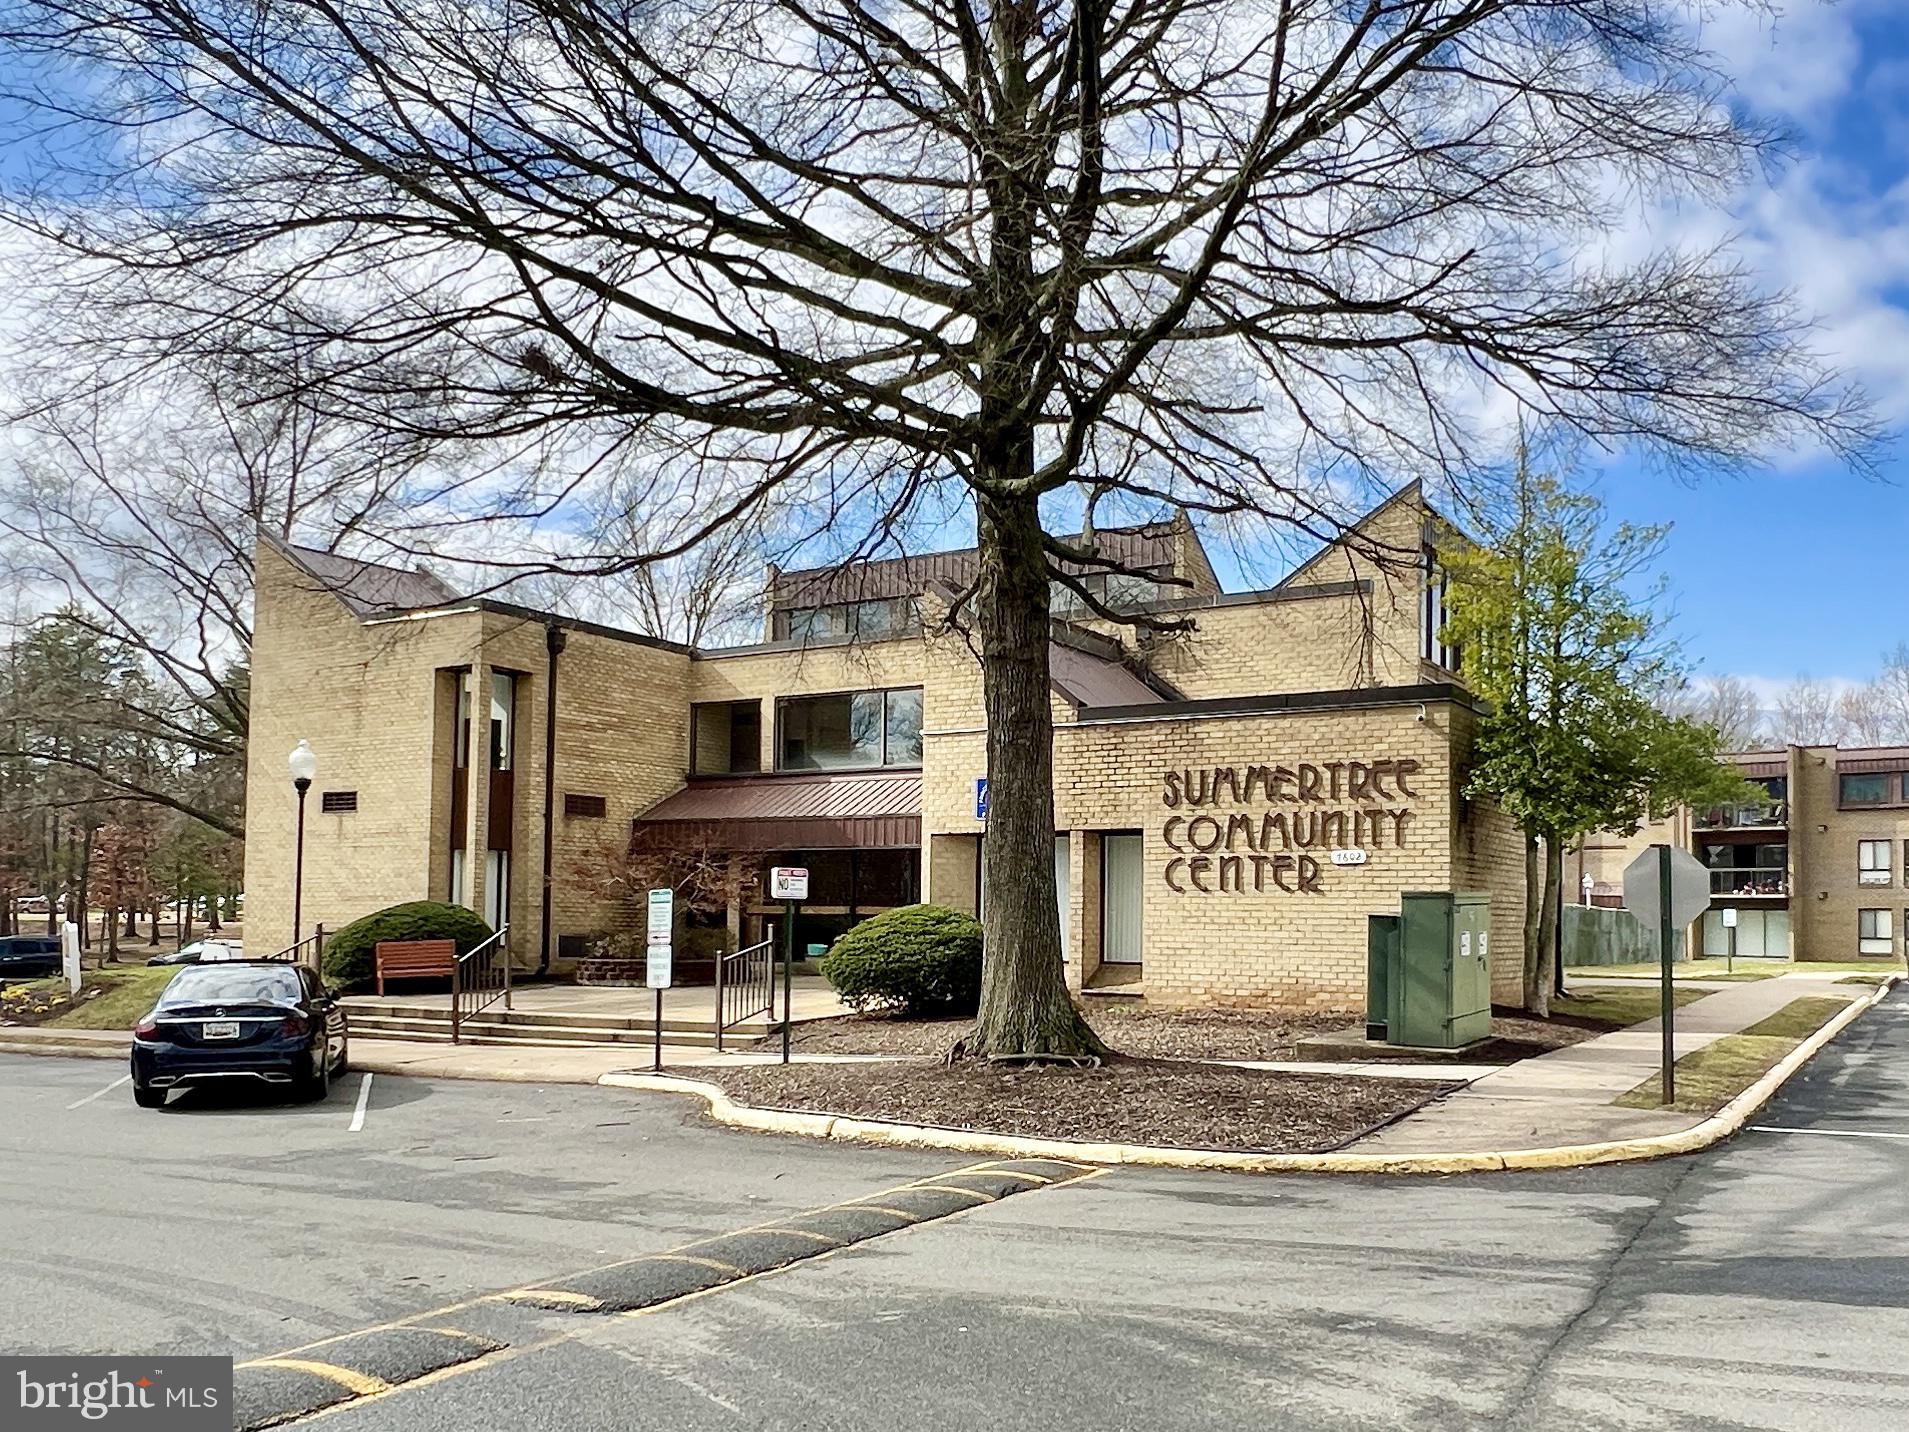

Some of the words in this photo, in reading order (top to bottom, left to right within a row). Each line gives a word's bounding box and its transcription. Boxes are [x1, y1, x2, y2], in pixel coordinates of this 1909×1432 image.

[1163, 759, 1420, 808] SUMMERTREE
[1163, 808, 1414, 852] COMMUNITY
[1164, 855, 1323, 894] CENTER
